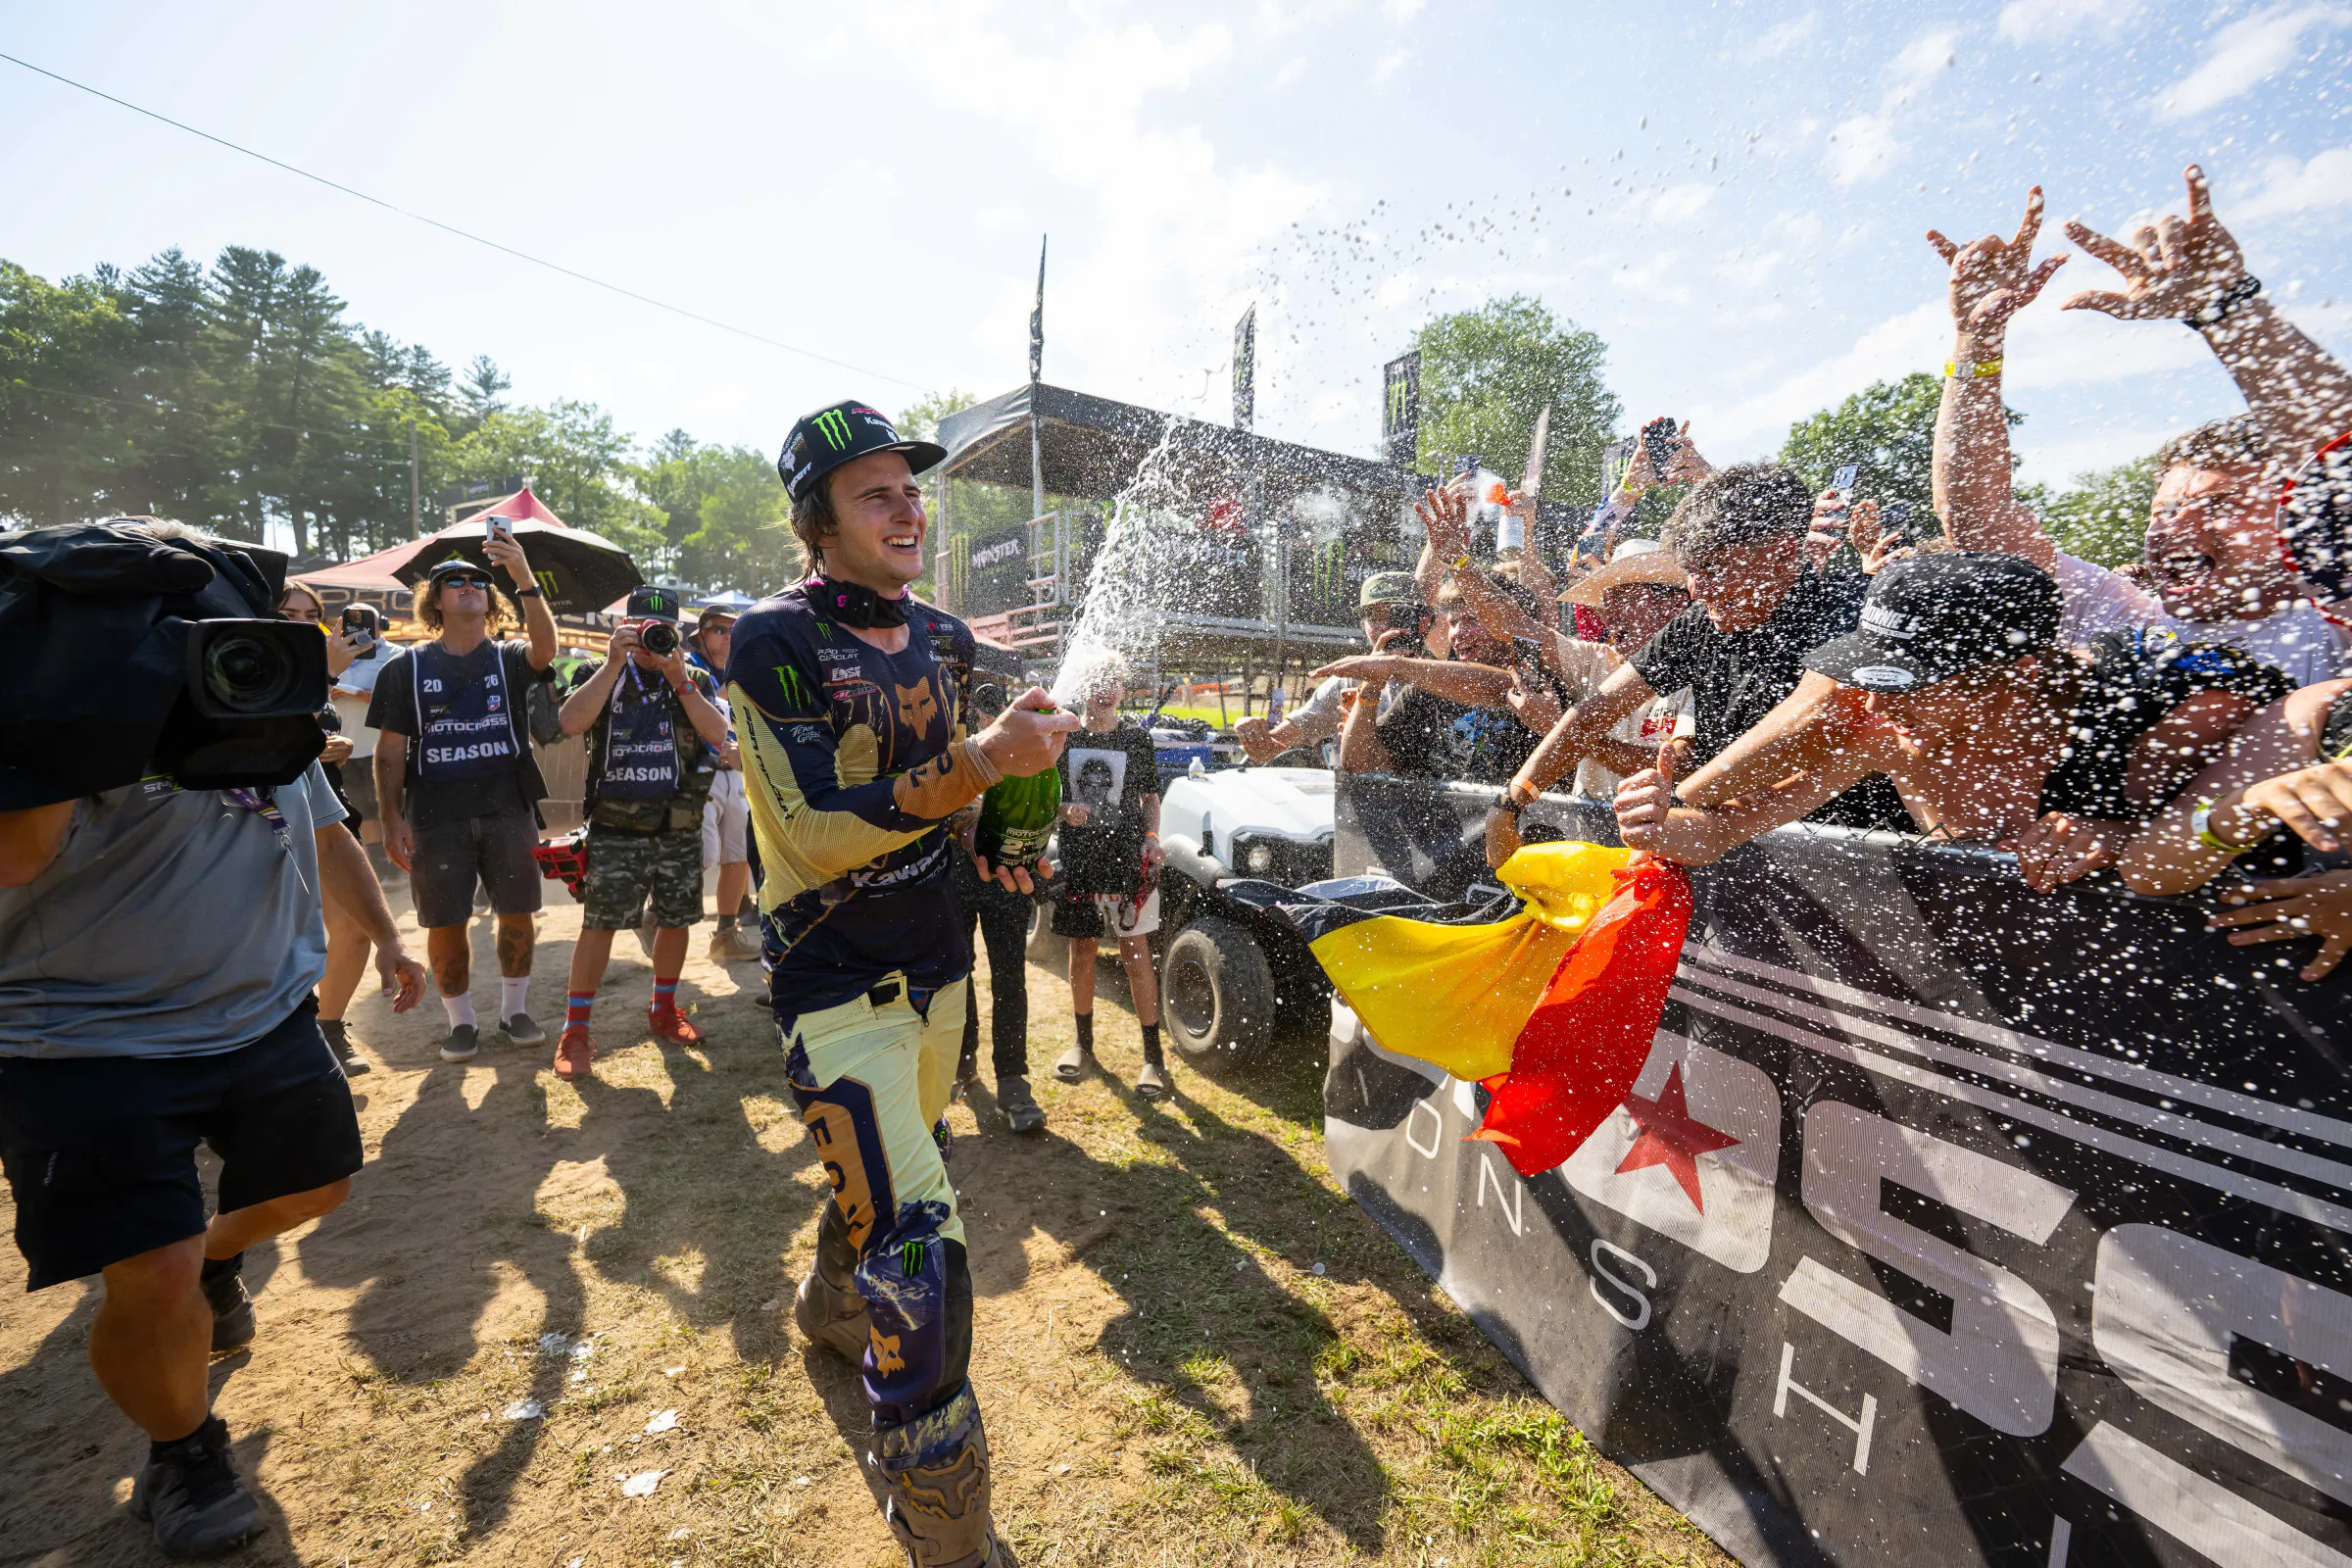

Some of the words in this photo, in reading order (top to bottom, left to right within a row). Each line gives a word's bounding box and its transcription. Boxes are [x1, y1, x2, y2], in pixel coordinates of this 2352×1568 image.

[818, 653, 859, 662] CIRCUIT
[423, 679, 443, 693] 20
[484, 674, 499, 689] 26
[790, 724, 814, 738] TEAM
[426, 741, 510, 763] SEASON
[612, 743, 673, 758] OTCROS
[605, 766, 673, 782] SEASON
[1005, 824, 1050, 838] MOTOC
[851, 836, 948, 888] Kawa
